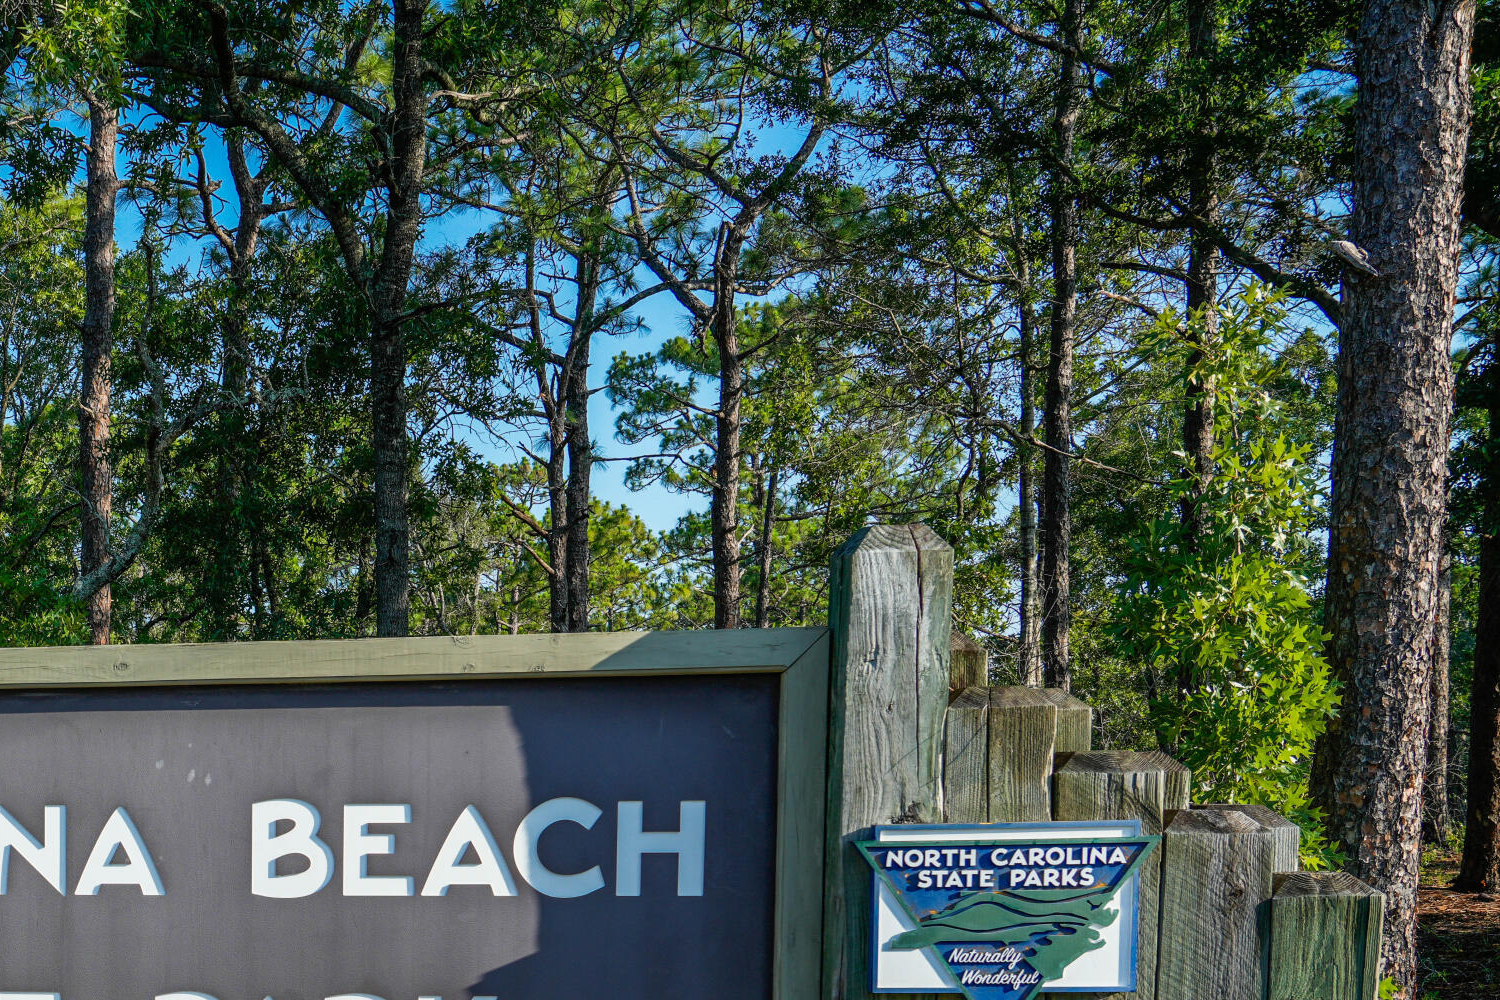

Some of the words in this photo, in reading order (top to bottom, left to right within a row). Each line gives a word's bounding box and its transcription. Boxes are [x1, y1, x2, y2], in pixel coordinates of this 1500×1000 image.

[251, 796, 706, 899] BEACH
[885, 849, 977, 867] NORTH
[990, 846, 1127, 866] CAROLINA
[917, 869, 994, 889] STATE
[1010, 868, 1094, 887] PARKS
[948, 947, 1022, 970] Naturally
[961, 969, 1040, 990] Wonderful
